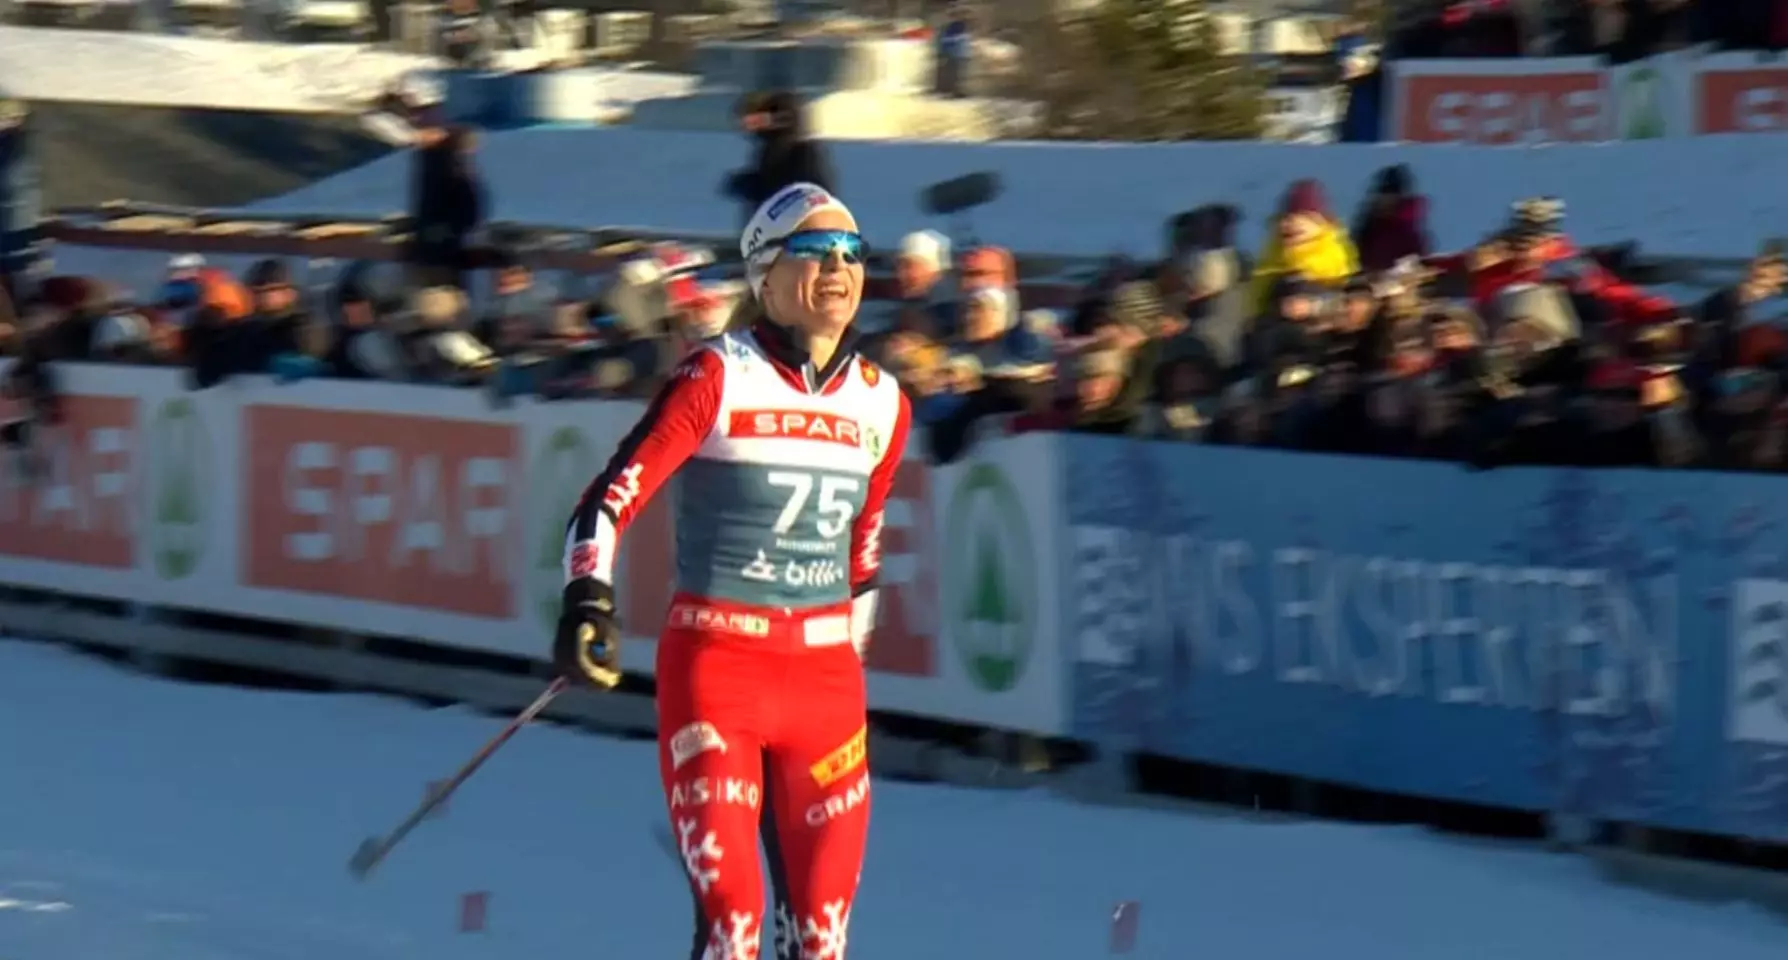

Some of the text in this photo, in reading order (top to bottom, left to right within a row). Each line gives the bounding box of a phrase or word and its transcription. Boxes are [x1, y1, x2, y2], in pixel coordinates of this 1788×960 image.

[754, 413, 860, 442] SPAR
[285, 440, 514, 582] SPAR
[767, 472, 860, 538] 75
[681, 608, 746, 632] SPAR
